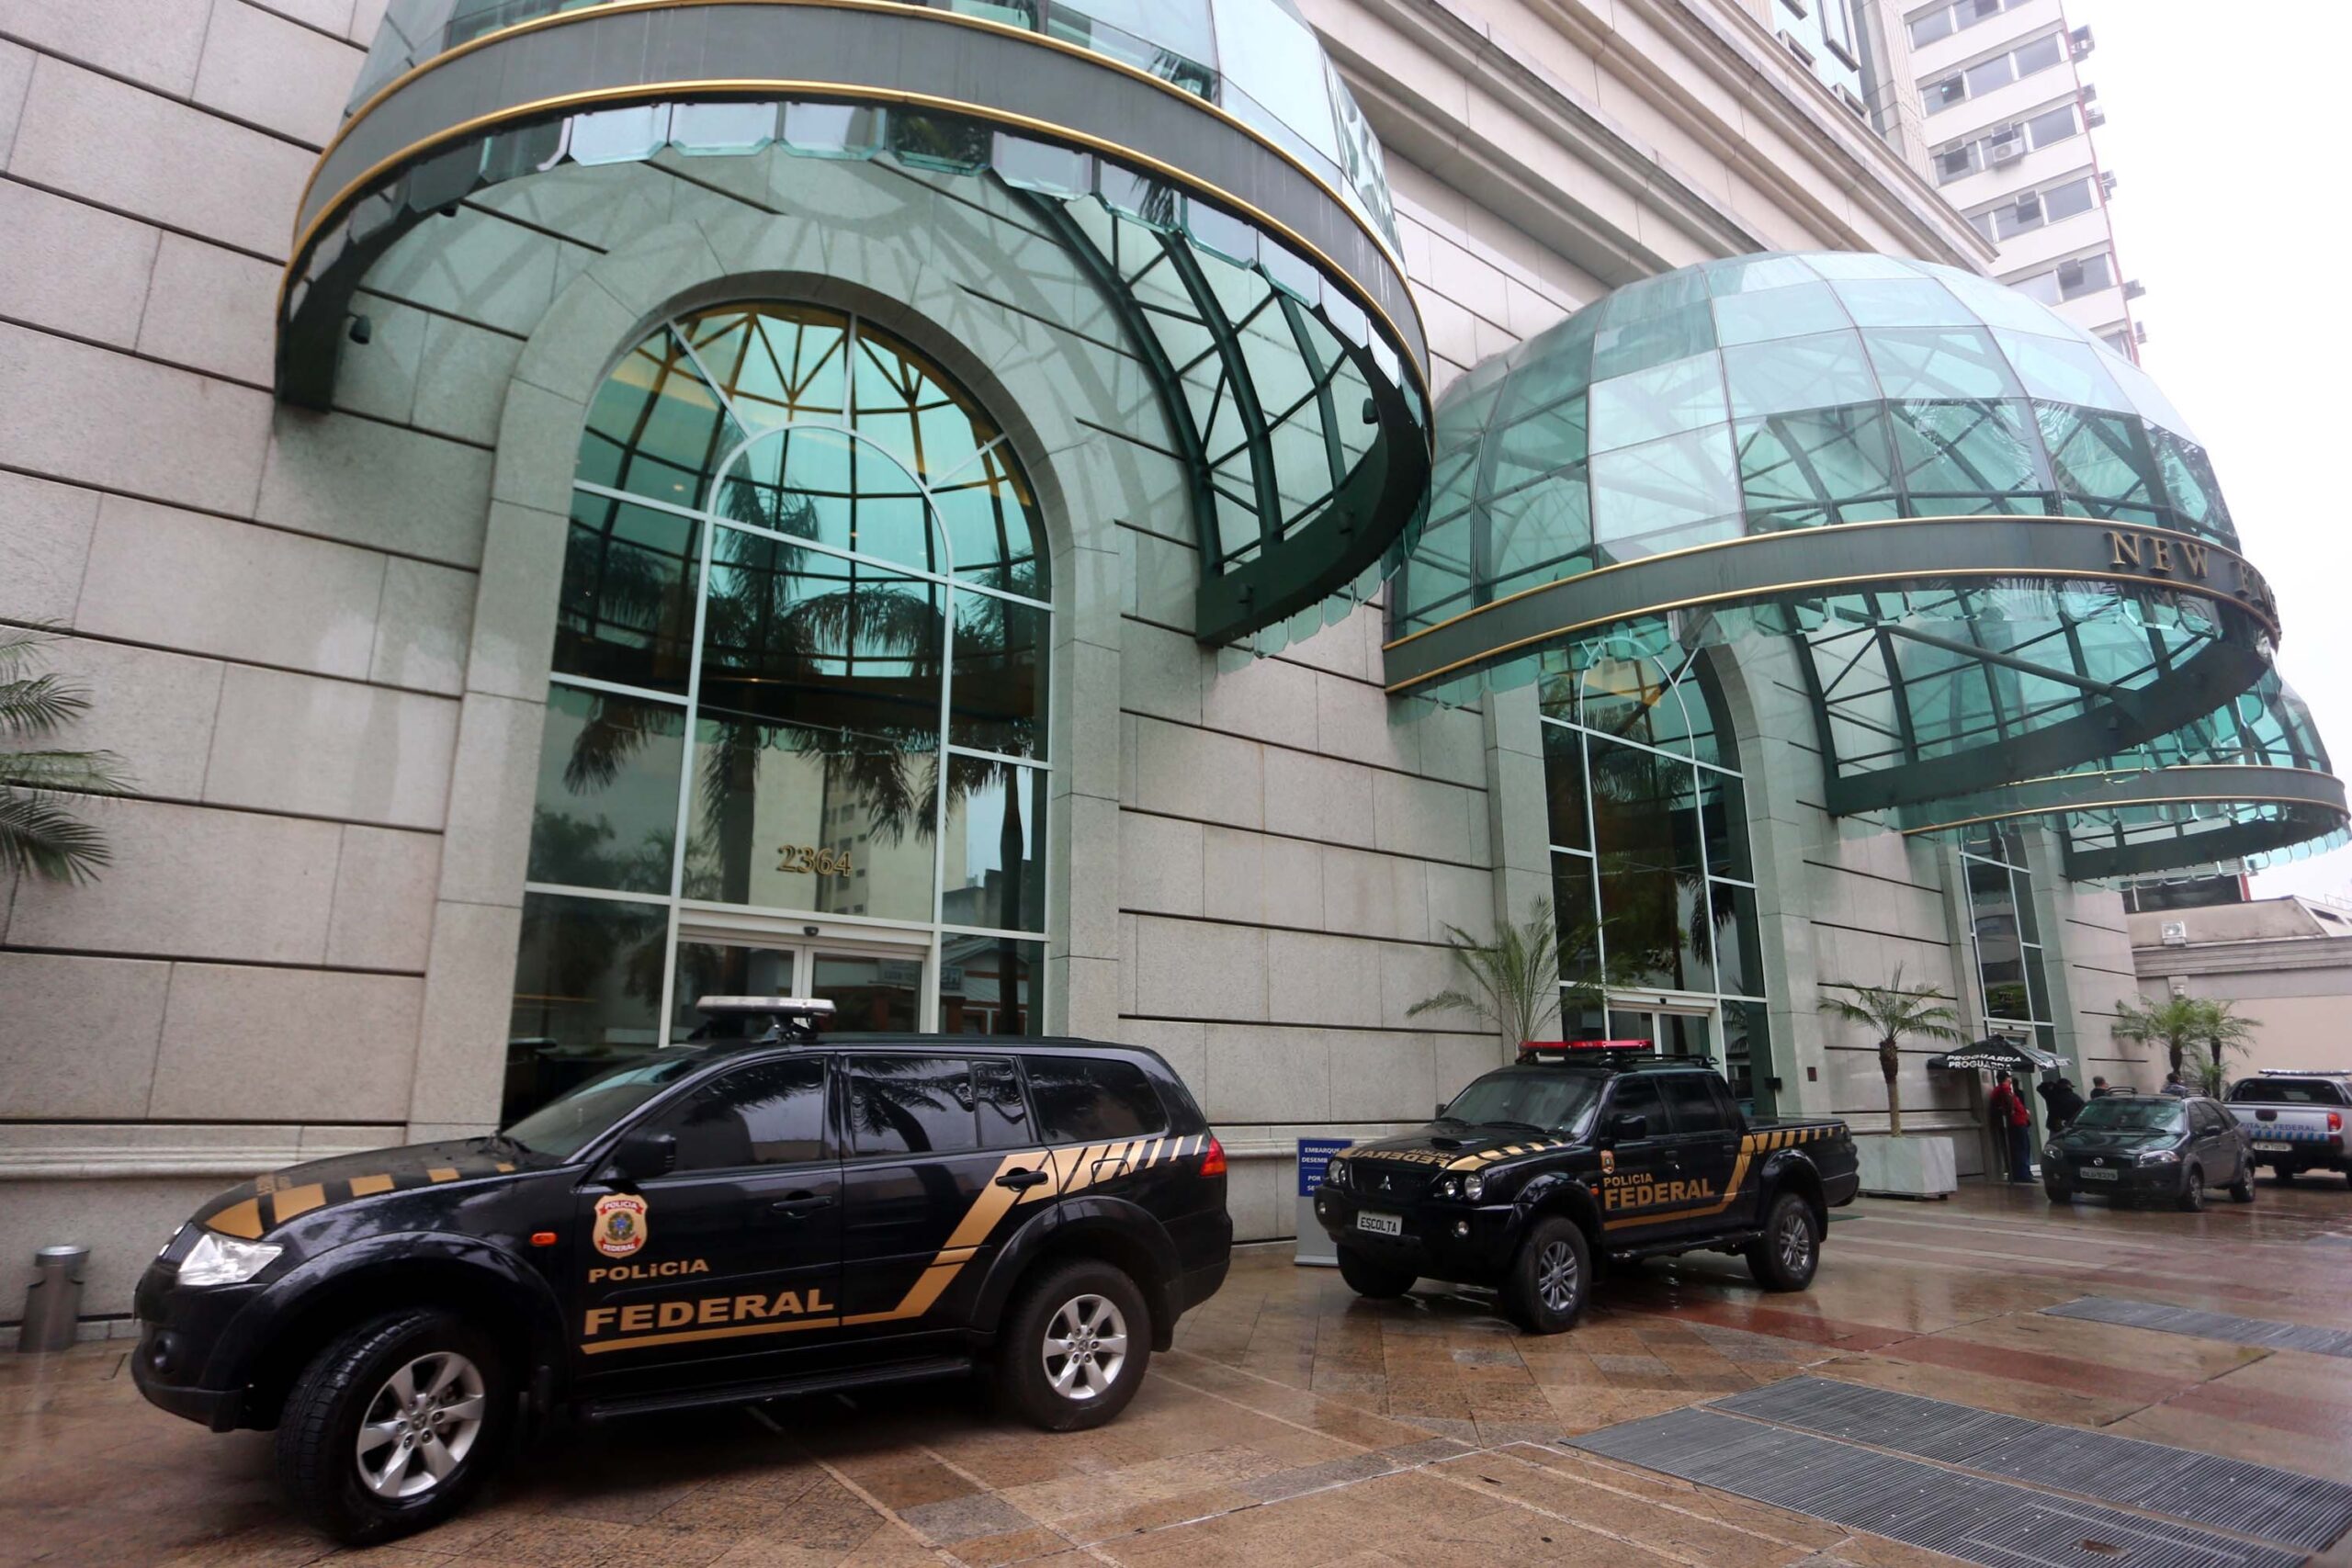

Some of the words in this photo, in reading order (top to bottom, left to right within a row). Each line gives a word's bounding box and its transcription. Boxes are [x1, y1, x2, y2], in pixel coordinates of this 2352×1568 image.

[2104, 530, 2209, 578] NEW
[776, 845, 853, 876] 2364
[1947, 1054, 2021, 1063] PROGUARDA
[2274, 1123, 2317, 1132] FEDERAL
[1603, 1173, 1654, 1188] POLICIA
[1604, 1178, 1715, 1211] FEDERAL
[1361, 1216, 1397, 1233] ESCOLTA
[584, 1289, 834, 1336] FEDERAL
